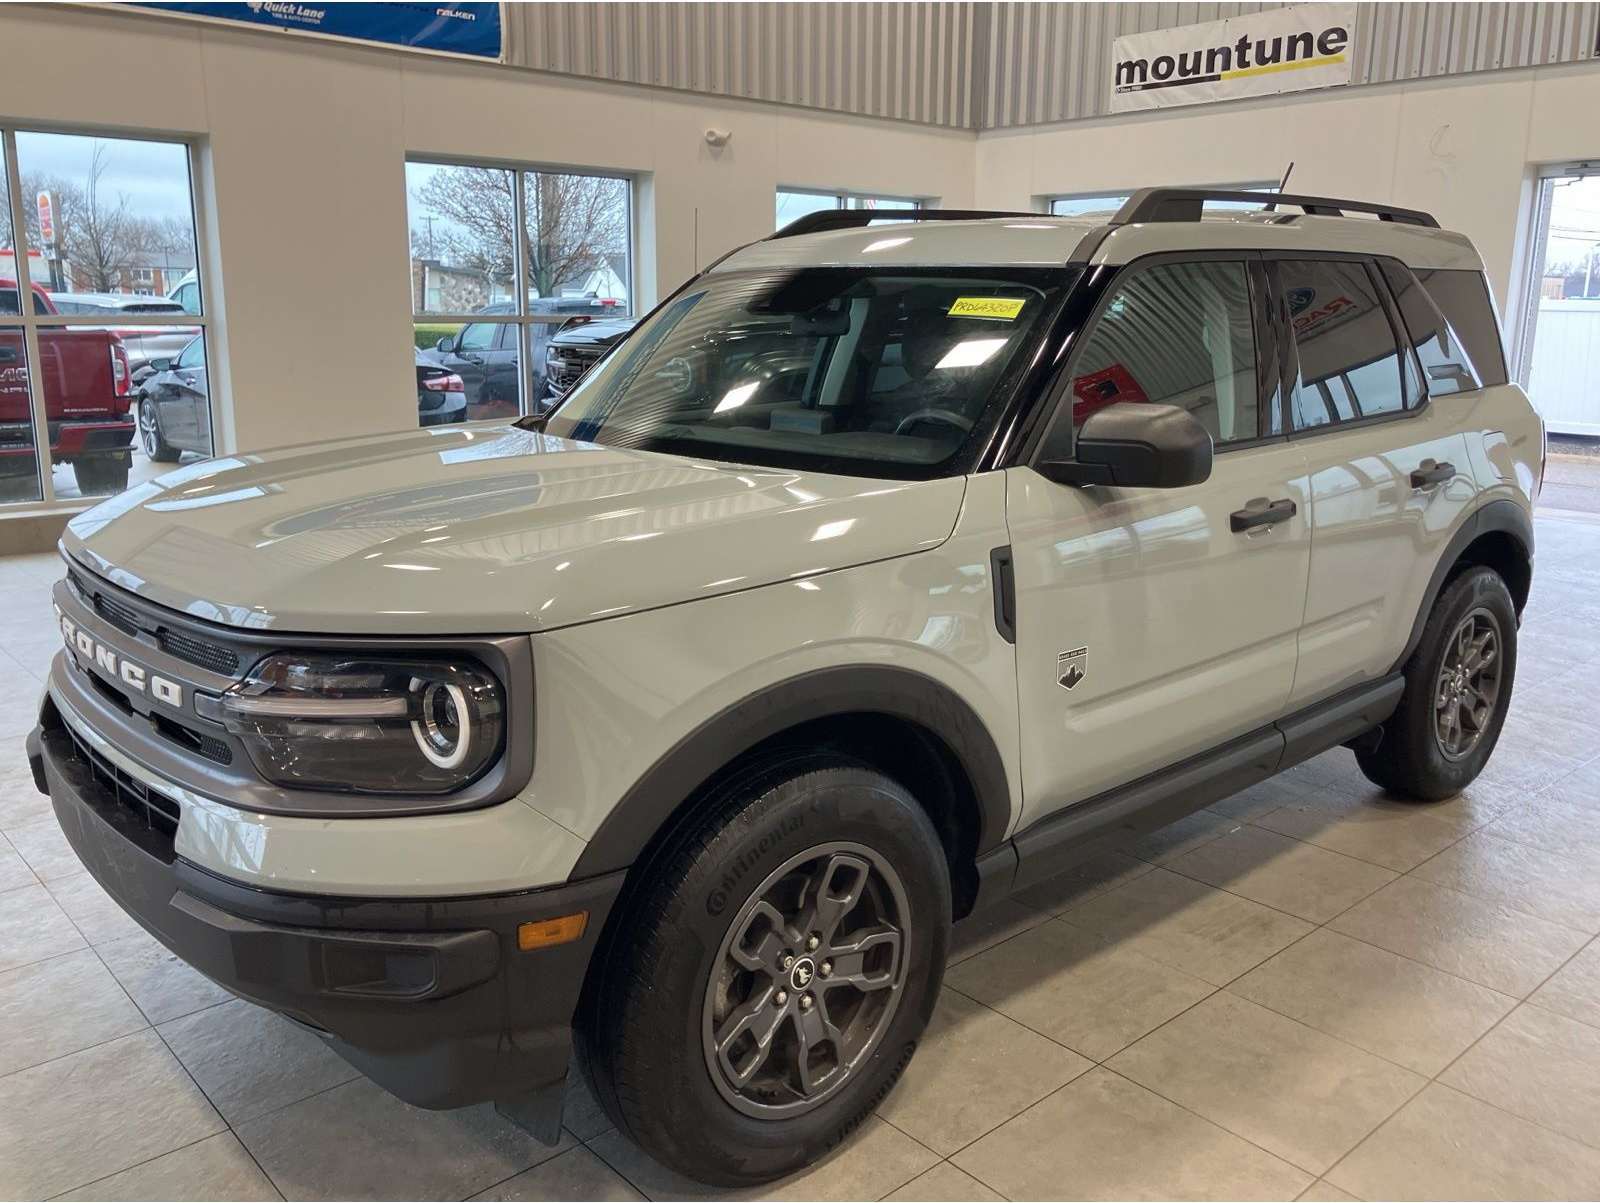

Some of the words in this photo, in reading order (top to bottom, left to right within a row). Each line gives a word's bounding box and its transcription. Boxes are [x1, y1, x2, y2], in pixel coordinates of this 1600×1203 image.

[264, 2, 295, 14] Quick
[297, 5, 325, 19] Lane
[1115, 26, 1349, 86] mountune
[54, 604, 183, 708] RONCO
